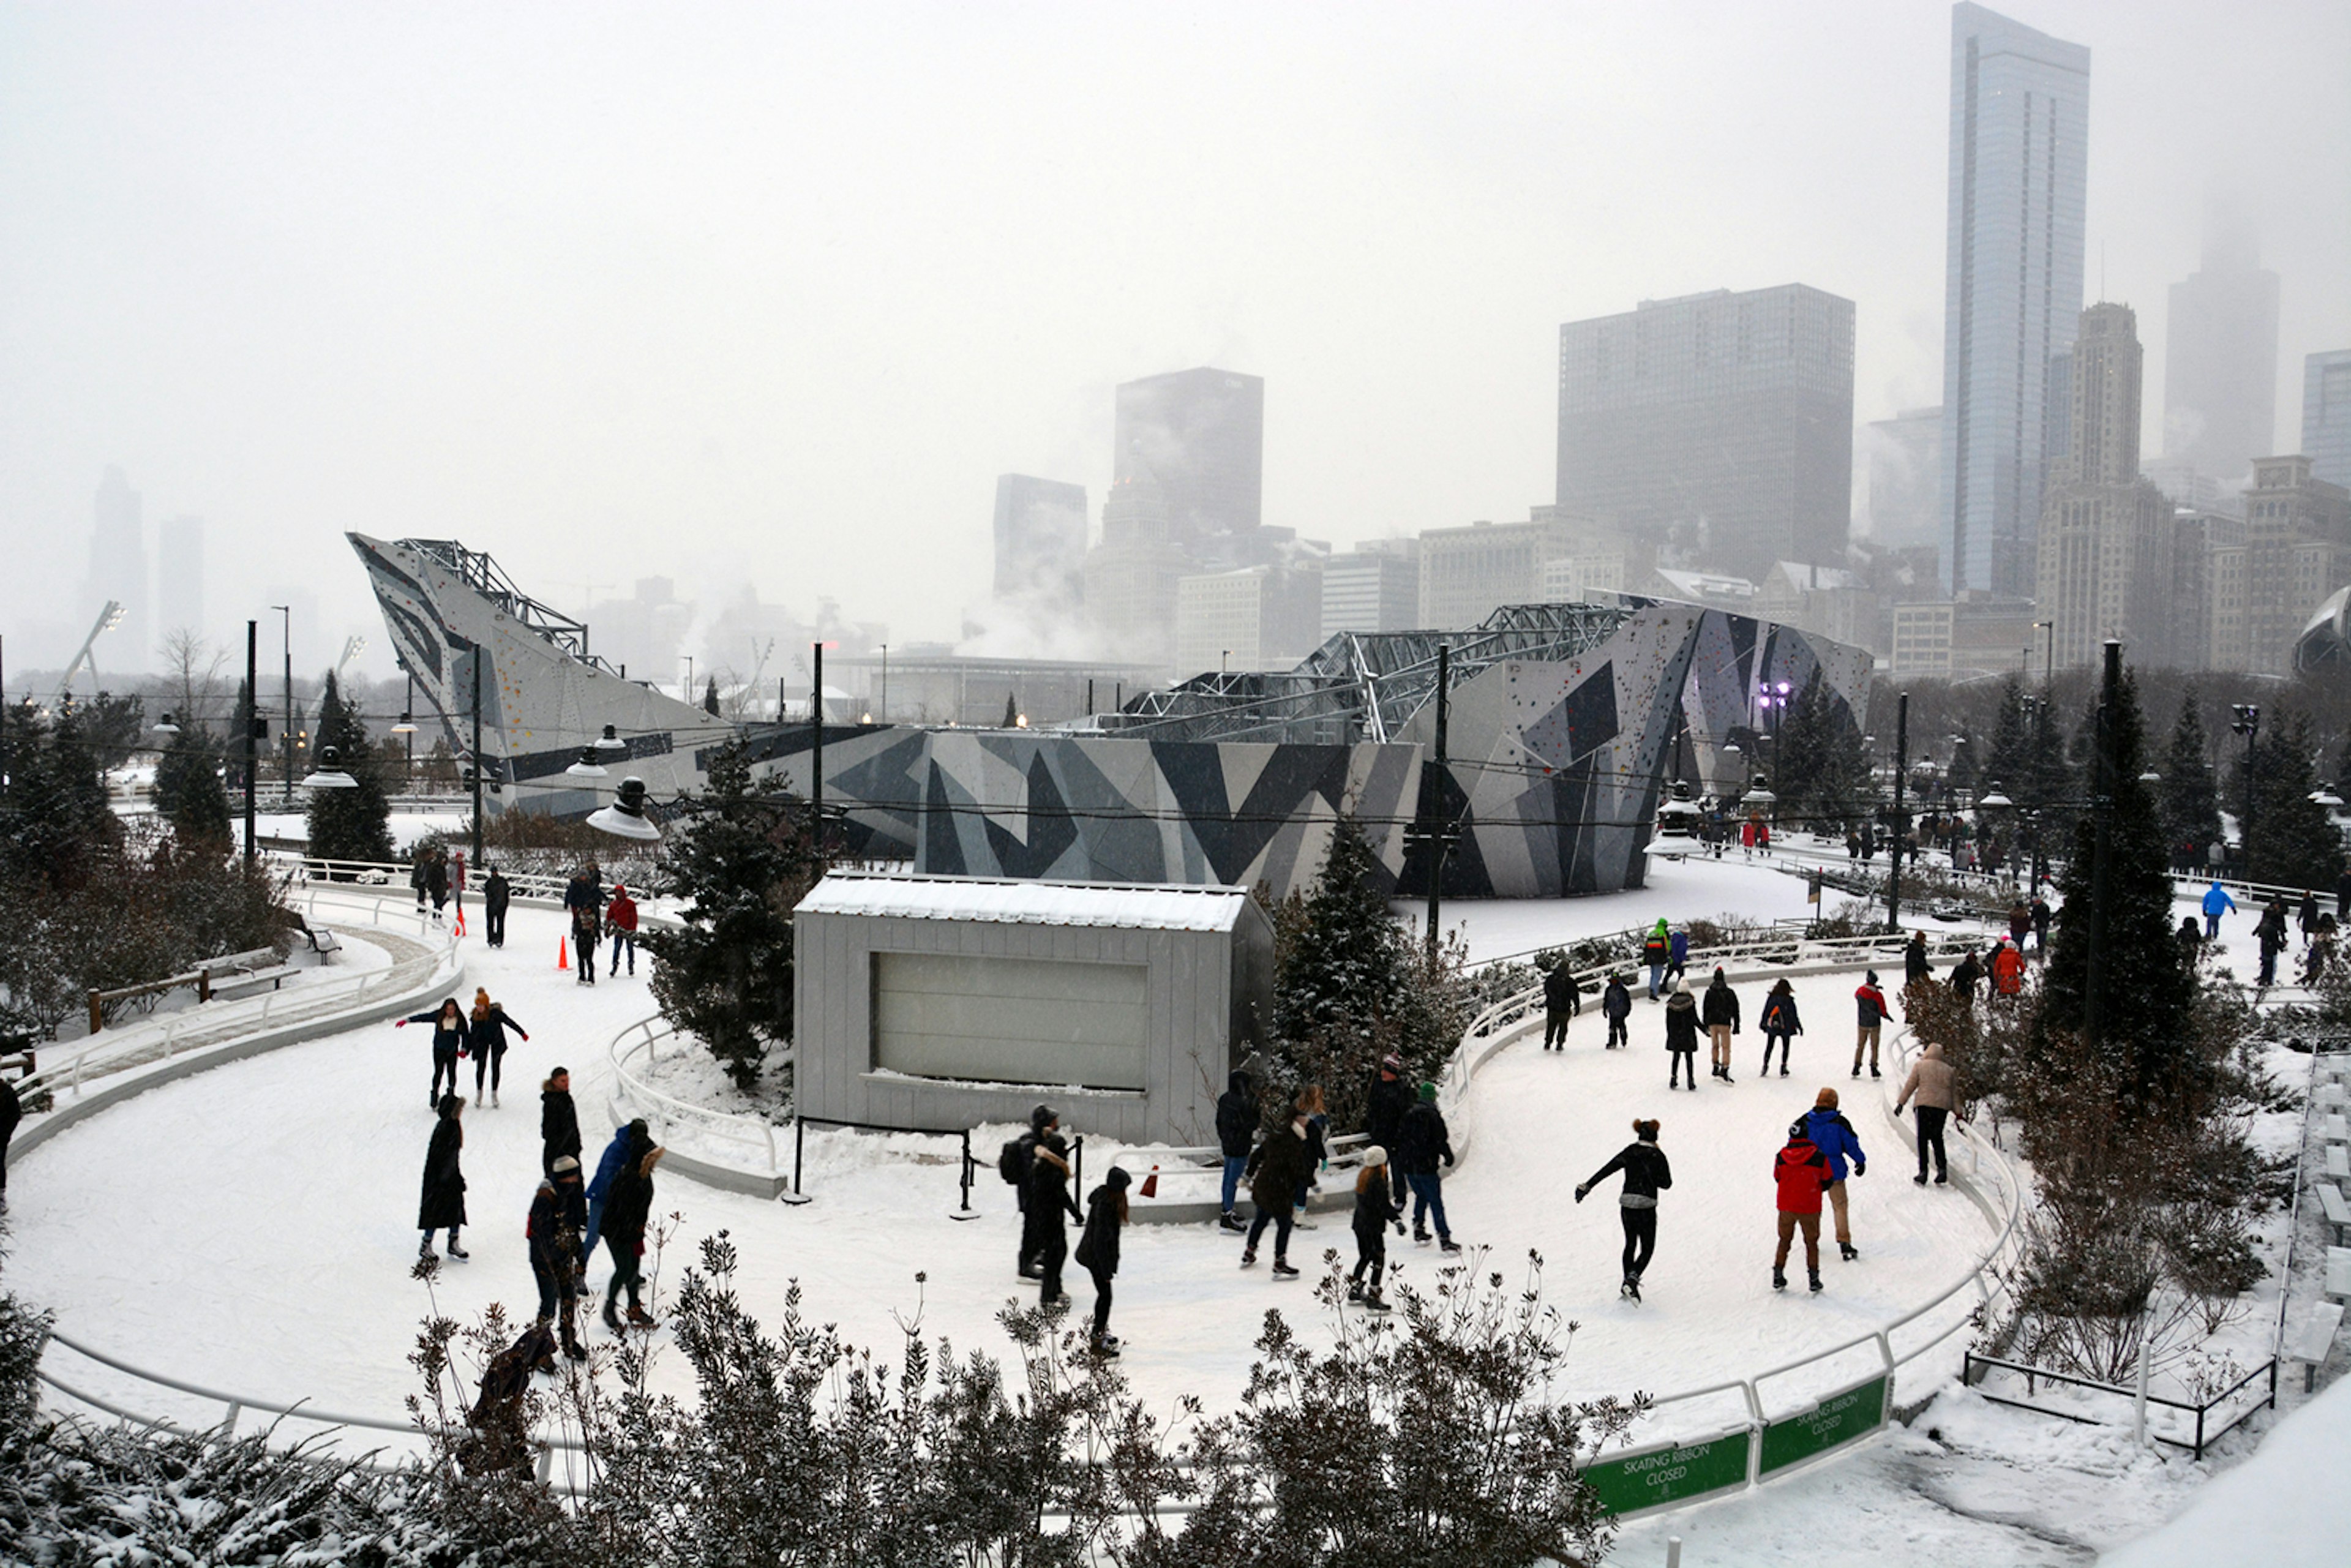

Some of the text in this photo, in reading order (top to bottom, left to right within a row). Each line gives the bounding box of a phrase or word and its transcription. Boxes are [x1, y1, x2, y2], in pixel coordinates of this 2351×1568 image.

[1812, 1414, 1842, 1435] CLOSED
[1624, 1444, 1710, 1474] SKATING RIBBON
[1646, 1466, 1687, 1487] CLOSED
